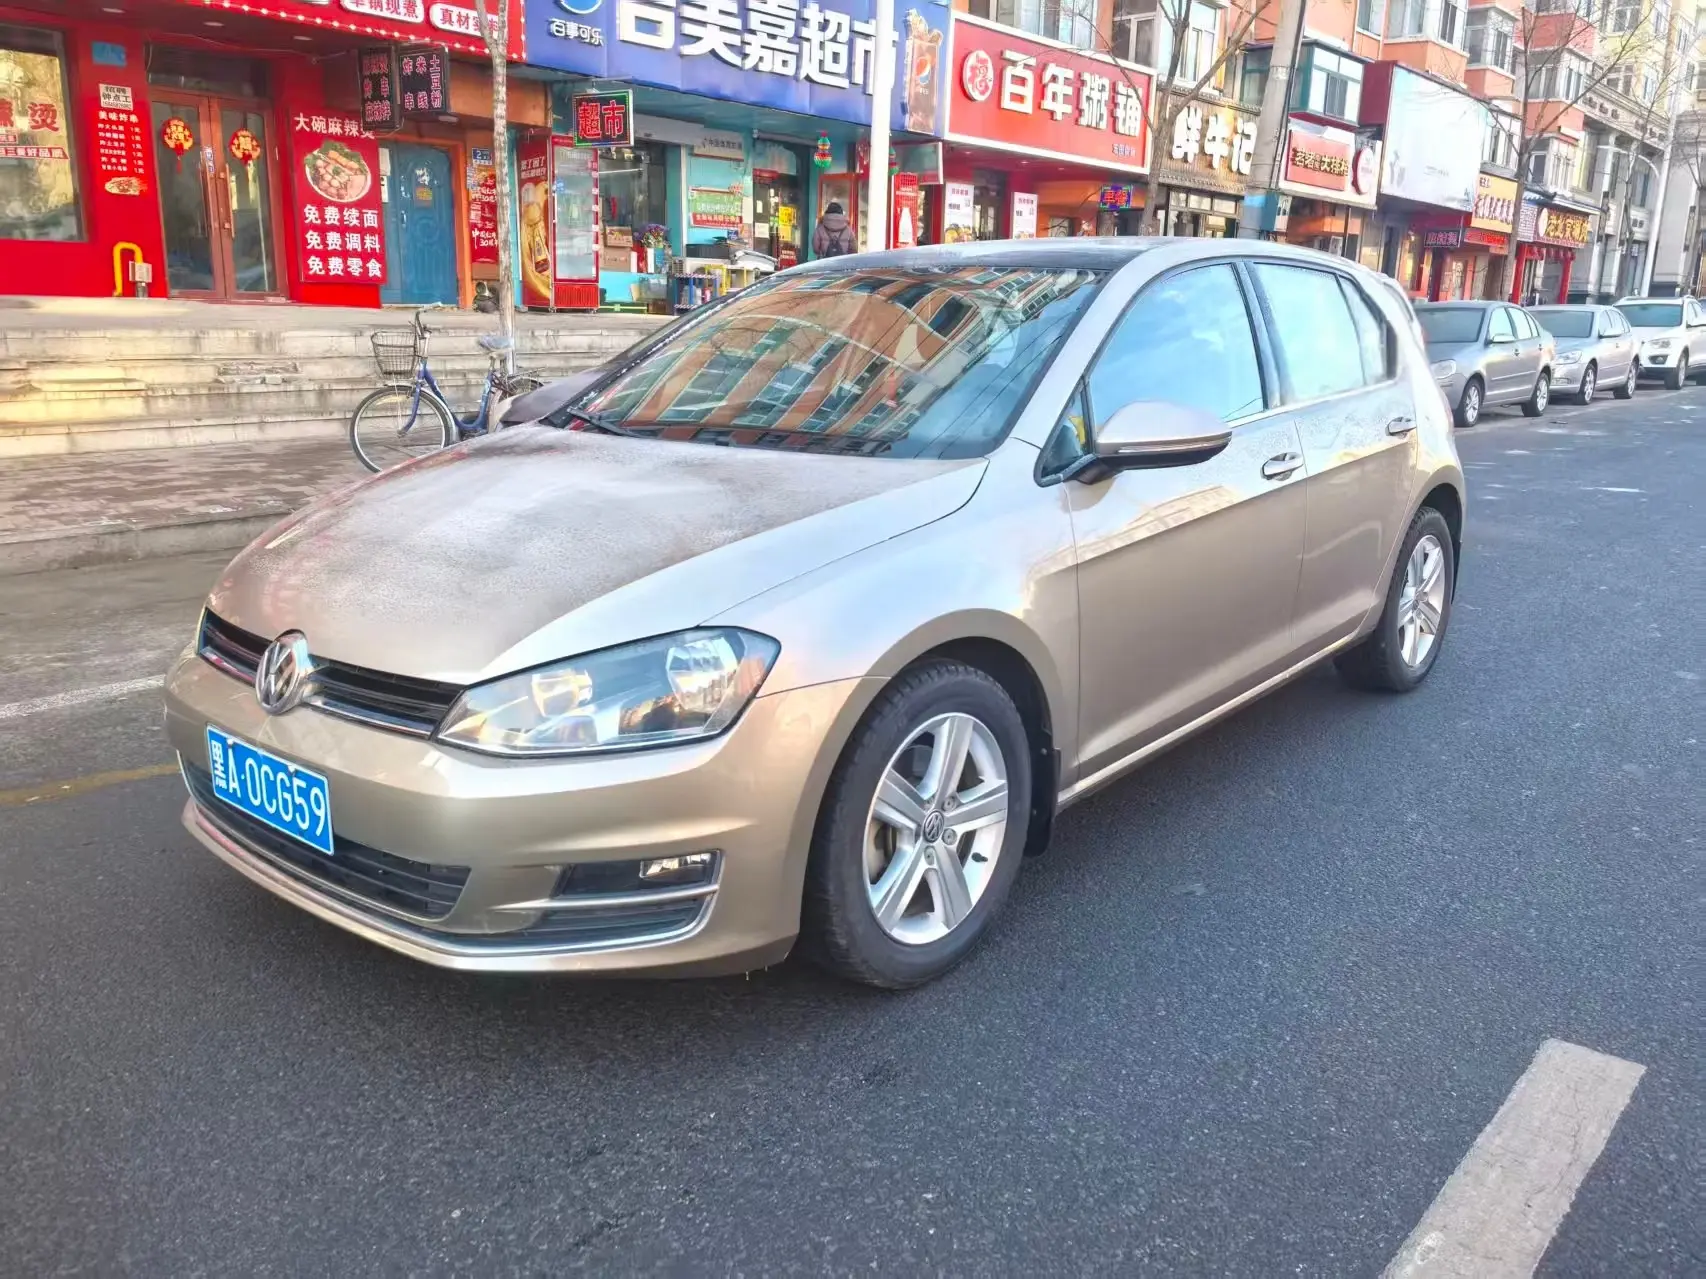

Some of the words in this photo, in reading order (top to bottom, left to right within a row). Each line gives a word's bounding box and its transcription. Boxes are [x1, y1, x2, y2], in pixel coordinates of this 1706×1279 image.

[549, 18, 604, 46] 百事可乐
[1000, 49, 1142, 137] 百年粥铺
[577, 100, 626, 139] 超市
[303, 204, 379, 228] 免费续面
[305, 229, 381, 253] 免费调料
[307, 255, 383, 278] 免费零食
